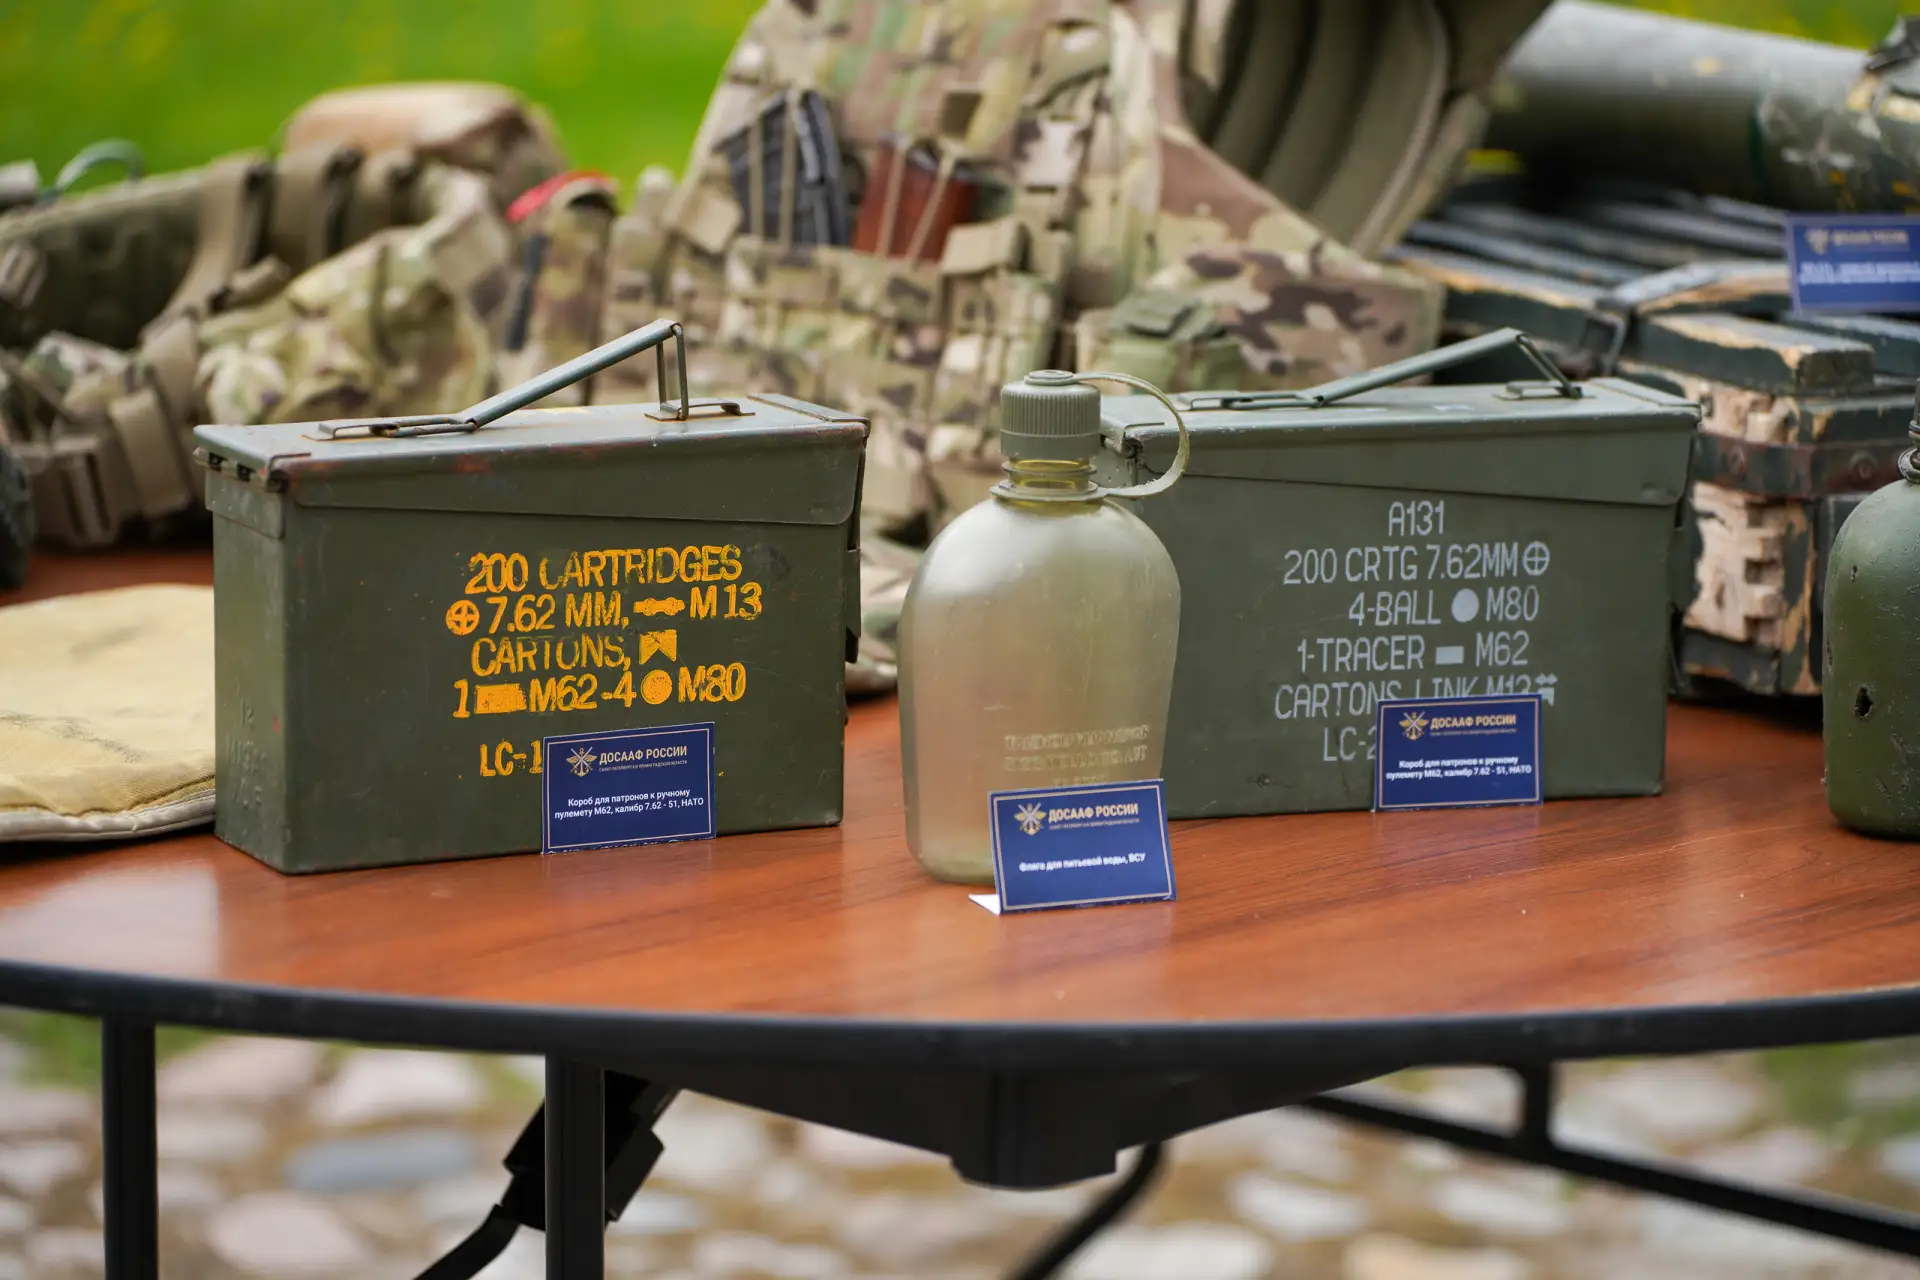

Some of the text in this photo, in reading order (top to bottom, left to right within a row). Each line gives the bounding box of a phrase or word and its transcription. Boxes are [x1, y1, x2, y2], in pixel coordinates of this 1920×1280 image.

[1388, 500, 1445, 537] A131
[464, 543, 743, 594] 200 CARTRIDGES
[1283, 540, 1518, 586] 200 CRTG 7.62MM
[485, 593, 556, 633] 7.62
[565, 590, 629, 630] MM,
[1348, 585, 1539, 627] 4-BALL M80
[1297, 629, 1529, 673] 1-TRACER M62
[453, 679, 470, 718] 1
[679, 662, 747, 703] M80
[1430, 714, 1517, 730] ДОСААФ РОССИИ
[599, 745, 688, 765] ДОСААФ РОССИИ
[1399, 759, 1424, 770] Короб
[1425, 759, 1440, 769] для
[1441, 757, 1478, 768] патронов
[1473, 767, 1491, 777] 7.62
[1509, 764, 1532, 775] НАТО
[555, 807, 593, 820] пулемету
[615, 803, 644, 814] калибр
[645, 801, 662, 811] 7.62
[669, 800, 680, 809] 51,
[681, 797, 704, 807] НАТО
[568, 796, 593, 807] Короб
[594, 795, 609, 805] для
[611, 793, 649, 804] патронов
[657, 789, 691, 800] ручному
[1048, 802, 1138, 823] ДОСААФ РОССИИ
